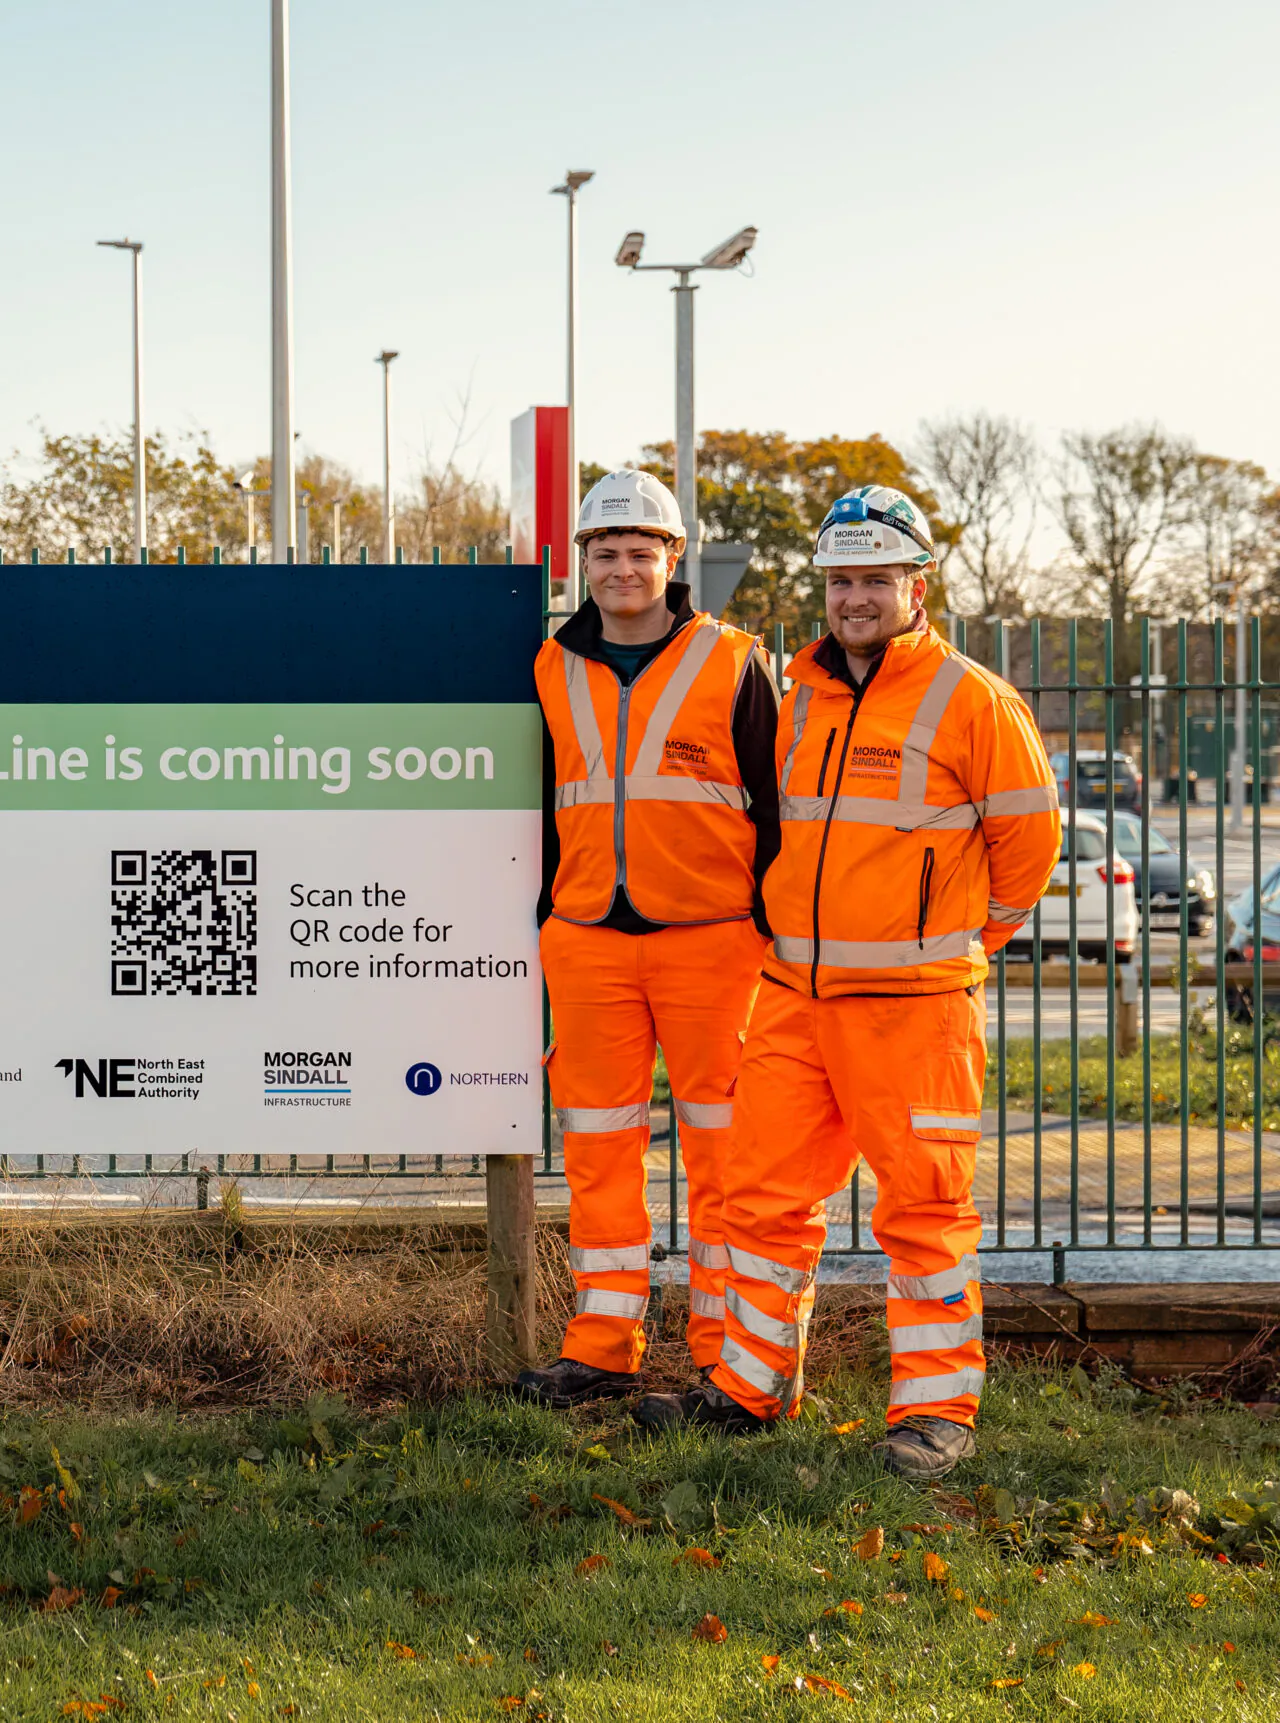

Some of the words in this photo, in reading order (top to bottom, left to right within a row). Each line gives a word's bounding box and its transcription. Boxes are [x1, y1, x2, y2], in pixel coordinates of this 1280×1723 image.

[834, 529, 873, 538] MORGAN
[834, 538, 871, 547] SINDALL
[665, 750, 708, 764] SINDALL
[852, 746, 900, 759] MORGAN
[105, 735, 143, 781] is
[159, 734, 351, 795] coming
[366, 746, 495, 781] soon
[851, 757, 897, 768] SINDALL
[289, 884, 352, 908] Scan
[361, 883, 406, 908] the
[289, 919, 330, 947] QR
[339, 918, 404, 943] code
[412, 917, 453, 943] for
[290, 960, 360, 979] more
[369, 952, 528, 979] information
[137, 1059, 179, 1070] North
[180, 1059, 206, 1070] East
[264, 1052, 352, 1067] MORGAN
[75, 1059, 136, 1098] NE
[137, 1072, 204, 1084] Combined
[264, 1069, 349, 1085] SINDALL
[450, 1072, 529, 1086] NORTHERN
[137, 1087, 200, 1100] Authority
[264, 1097, 352, 1107] INFRASTRUCTURE
